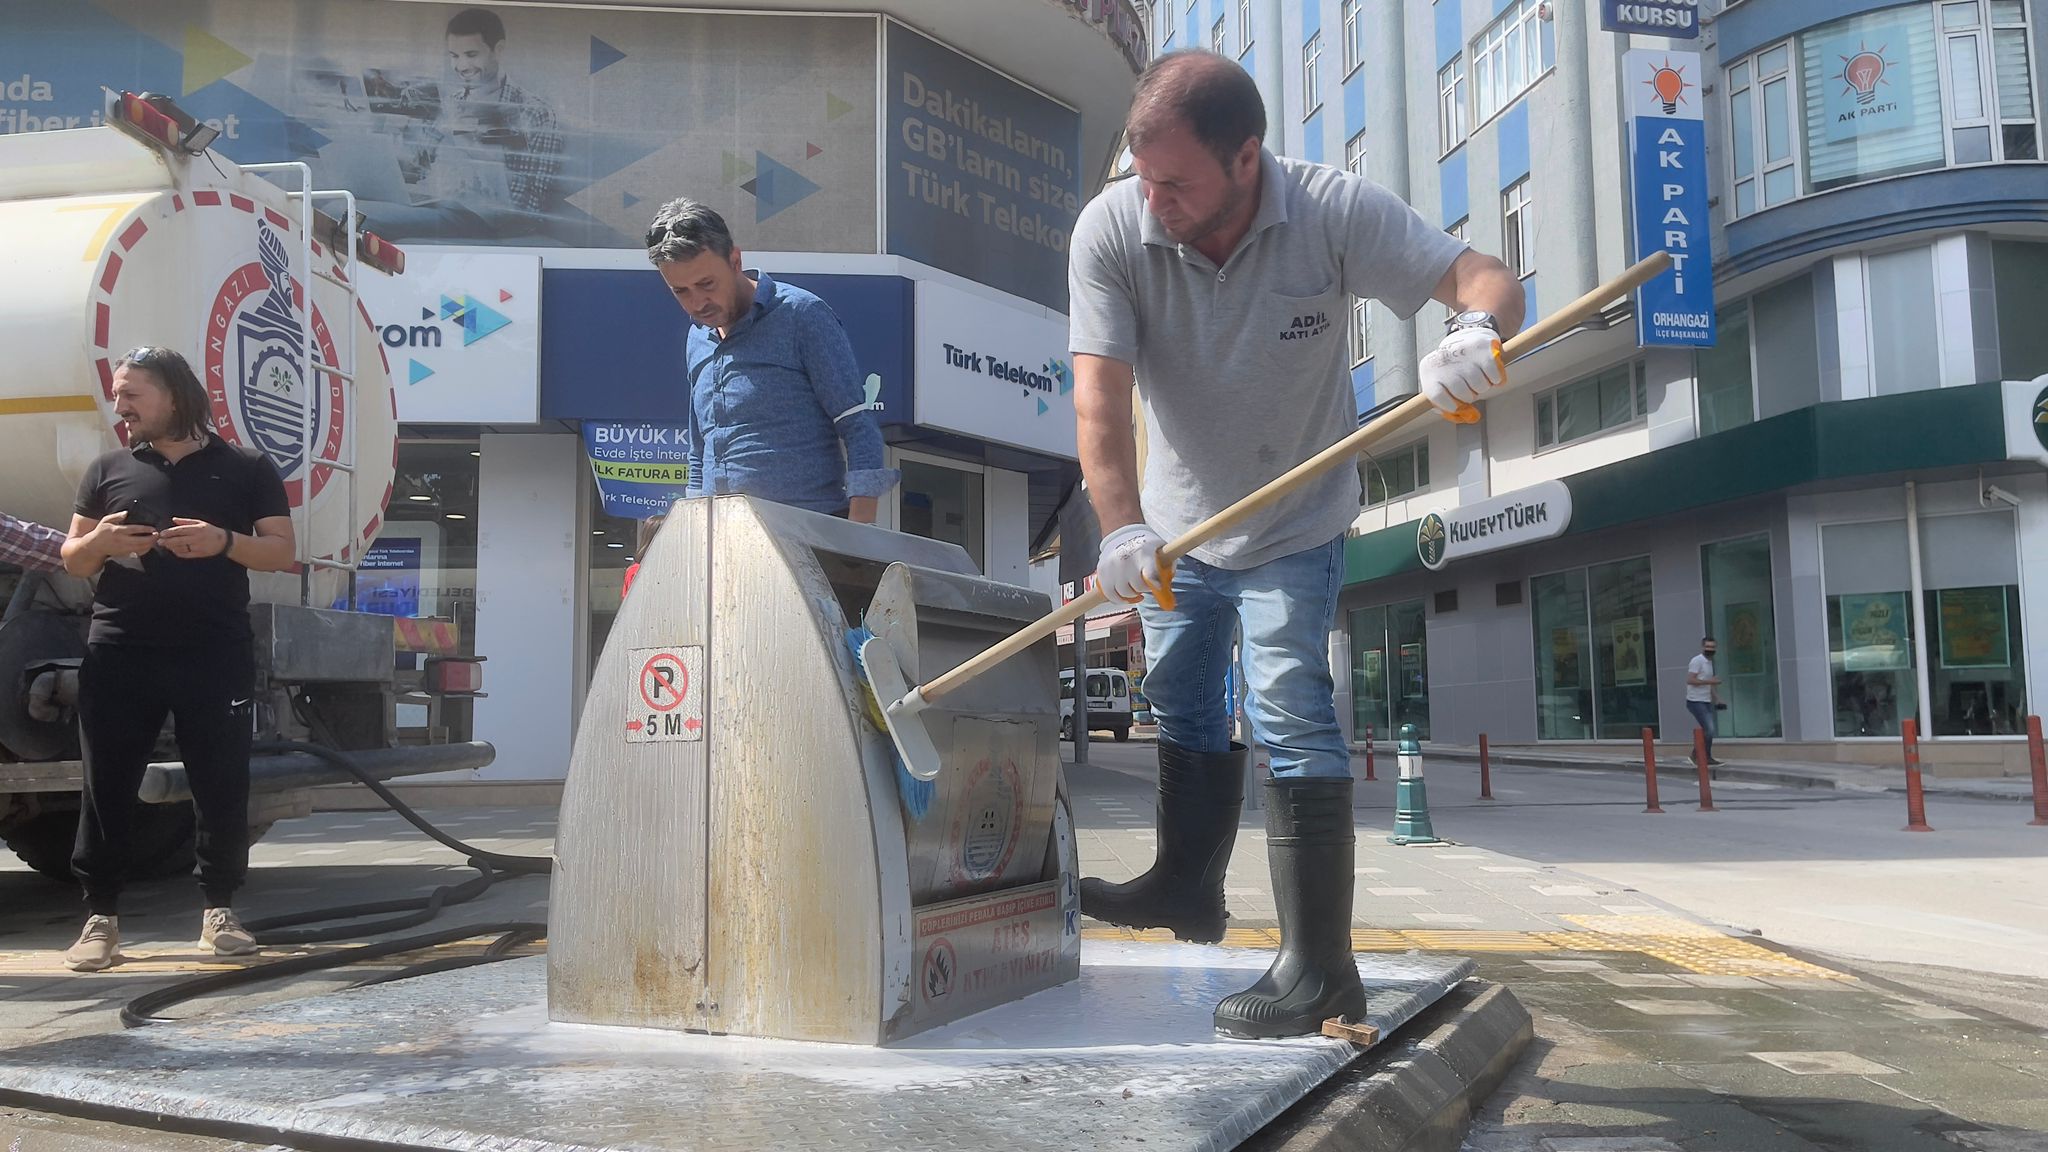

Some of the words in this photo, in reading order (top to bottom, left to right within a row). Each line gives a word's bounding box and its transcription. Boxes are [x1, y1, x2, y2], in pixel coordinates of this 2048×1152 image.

[1617, 4, 1692, 29] KURSU
[903, 72, 1072, 180] Dakikaların,
[1839, 111, 1855, 123] AK
[901, 161, 970, 218] Türk
[977, 191, 1070, 252] Teleko
[1291, 312, 1327, 328] ADİL
[1653, 311, 1709, 329] ORHANGAZİ
[377, 324, 442, 348] om
[1280, 331, 1308, 340] KATI
[943, 343, 982, 374] Türk
[985, 355, 1052, 393] Telekom
[595, 423, 668, 445] BÜYÜK
[594, 447, 626, 459] Evde
[630, 446, 654, 461] İşte
[594, 462, 613, 475] İLK
[618, 467, 670, 480] FATURA
[621, 494, 668, 508] Telekom
[646, 714, 658, 736] 5
[664, 713, 681, 736] M
